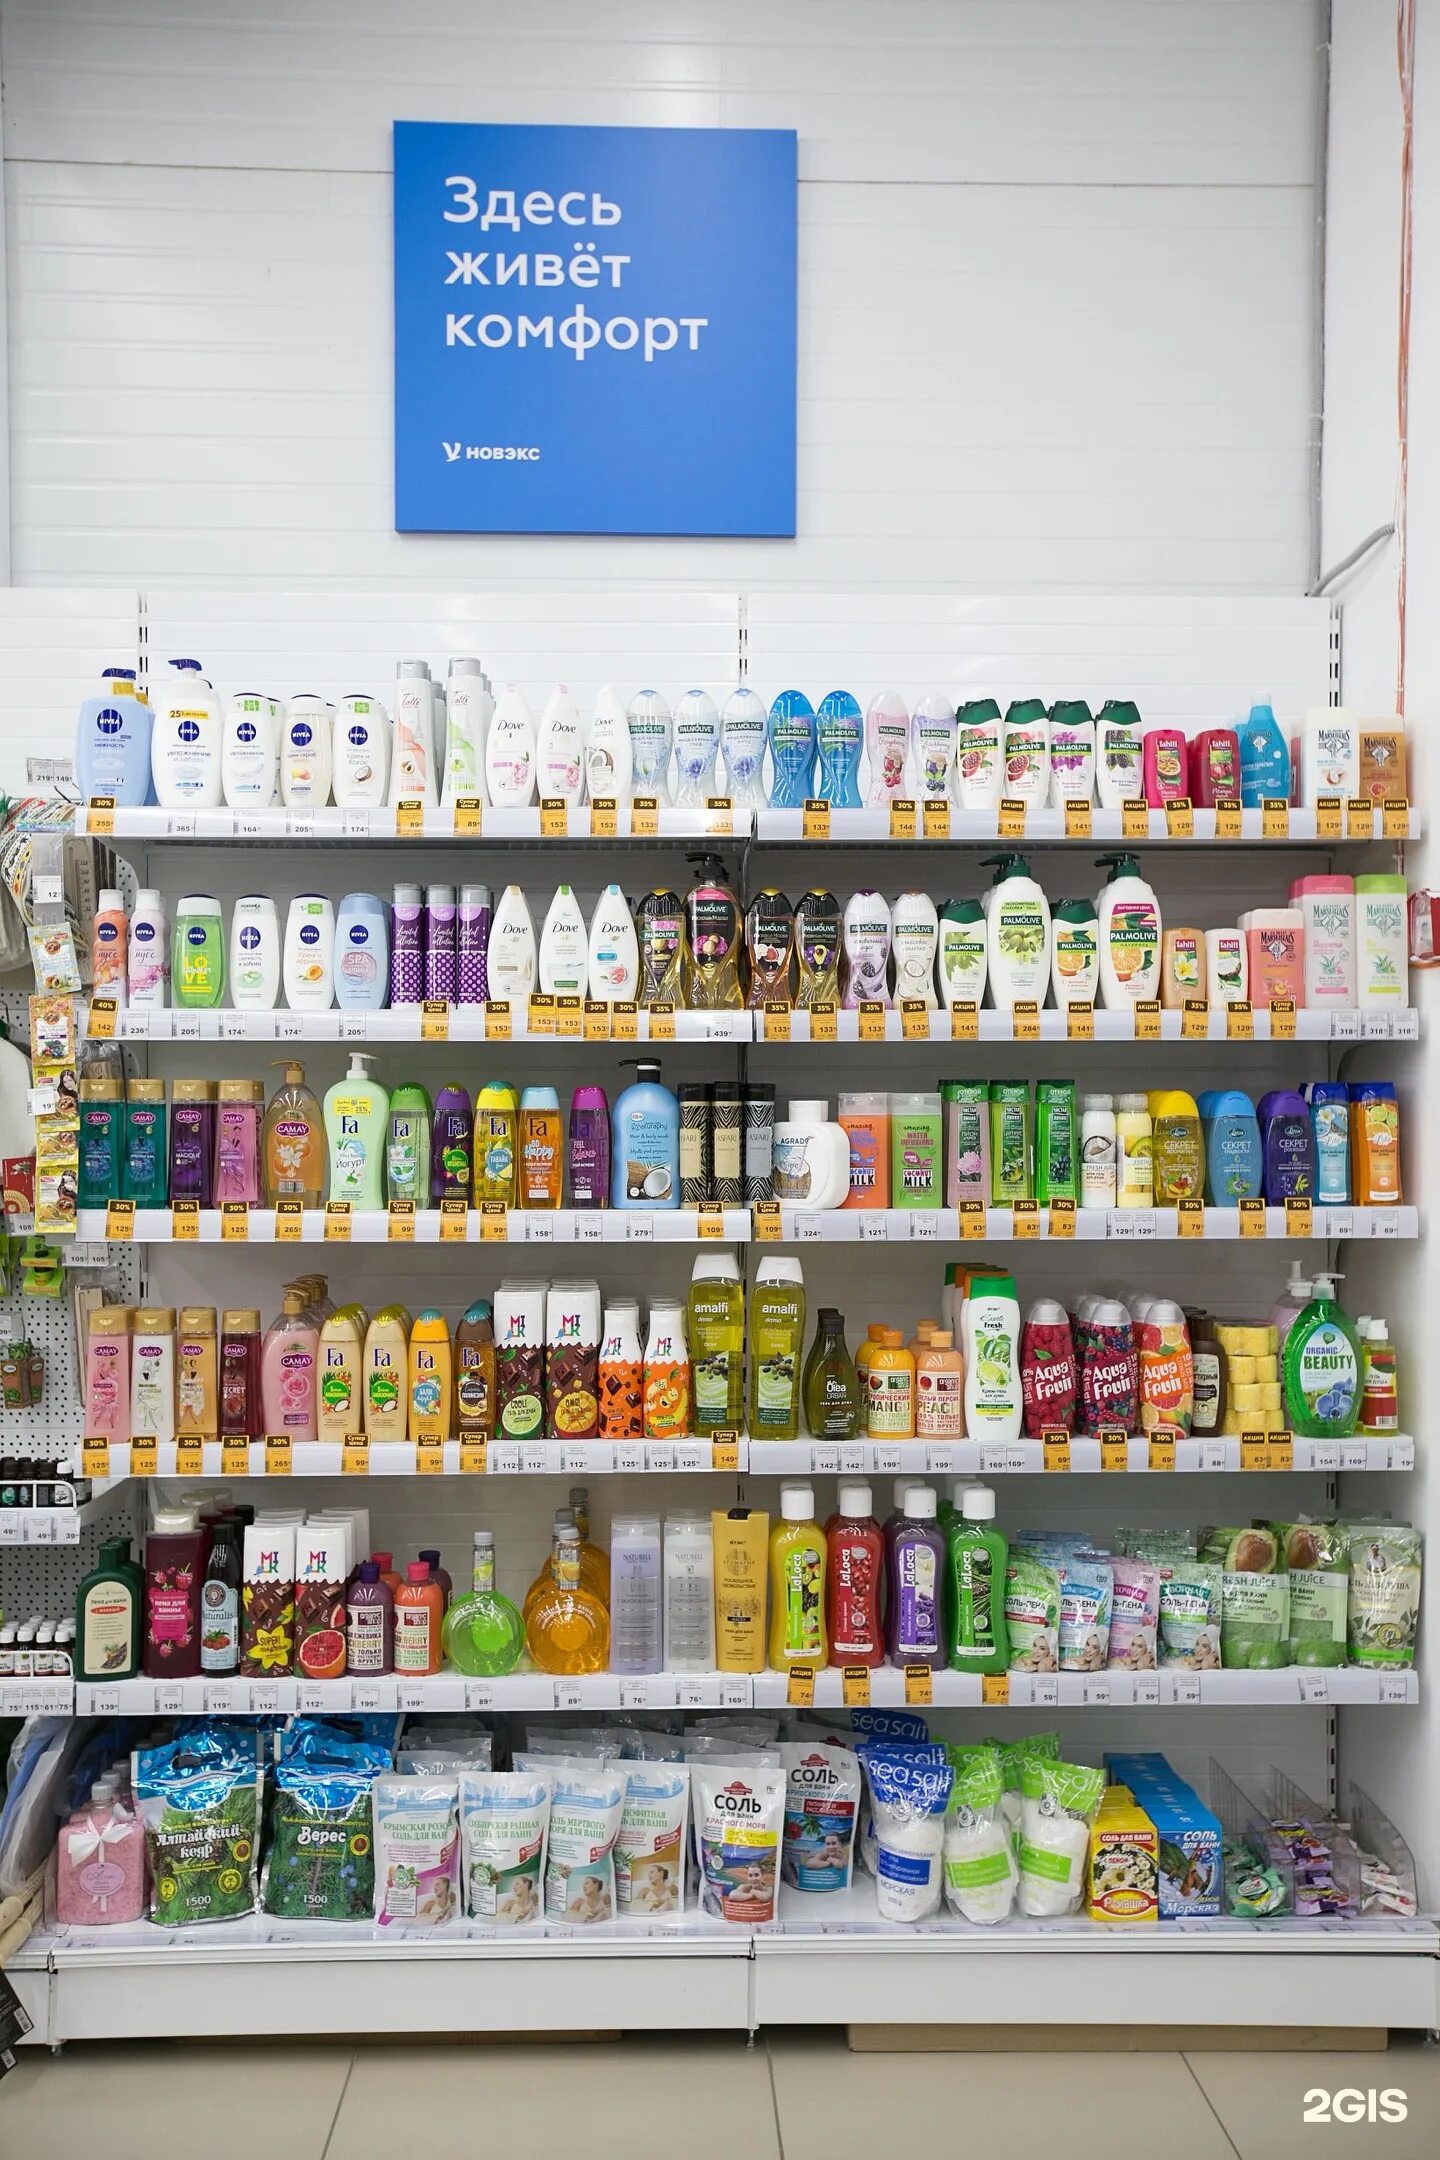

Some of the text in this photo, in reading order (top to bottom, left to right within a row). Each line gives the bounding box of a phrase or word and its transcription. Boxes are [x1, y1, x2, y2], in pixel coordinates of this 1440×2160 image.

[443, 175, 621, 232] Здесь
[444, 242, 631, 288] живёт
[445, 303, 708, 362] комфорт
[497, 719, 524, 731] Dove
[551, 720, 576, 733] Dove
[595, 718, 614, 727] Dove
[631, 725, 665, 733] PALMOLIVE
[962, 739, 994, 748] PALMOLIVE
[1010, 743, 1041, 752] PALMOLIVE
[1319, 800, 1339, 808] АКЦИЯ
[1003, 916, 1040, 925] PALMOLIVE
[502, 923, 528, 935] Dove
[552, 922, 579, 932] Dove
[601, 923, 628, 932] Dove
[1110, 932, 1156, 941] PALMOLIVE
[177, 1113, 200, 1121] CAMAY
[277, 1124, 308, 1134] CAMAY
[342, 1116, 359, 1134] Fa
[394, 1119, 409, 1137] Fa
[449, 1117, 467, 1136] Fa
[490, 1118, 508, 1135] Fa
[529, 1118, 548, 1136] Fa
[1164, 1140, 1196, 1150] СЕКРЕТ
[1222, 1141, 1252, 1150] СЕКРЕТ
[1278, 1139, 1308, 1148] СЕКРЕТ
[904, 1177, 931, 1186] MILK
[695, 1302, 728, 1314] amalfi
[762, 1303, 798, 1315] amalfi
[182, 1347, 203, 1355] CAMAY
[225, 1347, 246, 1355] CAMAY
[462, 1347, 481, 1366] Fa
[1305, 1347, 1338, 1355] ORGANIC
[281, 1356, 312, 1365] CAMAY
[327, 1348, 344, 1367] Fa
[374, 1348, 392, 1367] Fa
[417, 1350, 434, 1369] Fa
[1303, 1355, 1352, 1370] BEAUTY
[1035, 1361, 1069, 1381] Aqua
[1093, 1361, 1128, 1381] Aqua
[1143, 1361, 1178, 1380] Aqua
[840, 1549, 850, 1587] LaLoca
[904, 1549, 915, 1588] LaLoca
[962, 1551, 971, 1588] LaLoca
[791, 1669, 811, 1677] АКЦИЯ
[791, 1769, 838, 1784] СОЛЬ
[714, 1795, 762, 1813] СОЛЬ
[156, 1824, 240, 1847] Алтайский
[297, 1826, 346, 1844] Верес
[393, 1831, 412, 1840] СОЛЬ
[1184, 1831, 1217, 1841] СОЛЬ
[186, 1895, 211, 1907] 1500
[303, 1894, 328, 1904] 1500
[1103, 1897, 1149, 1909] Ромашка
[1164, 1902, 1219, 1915] Морская
